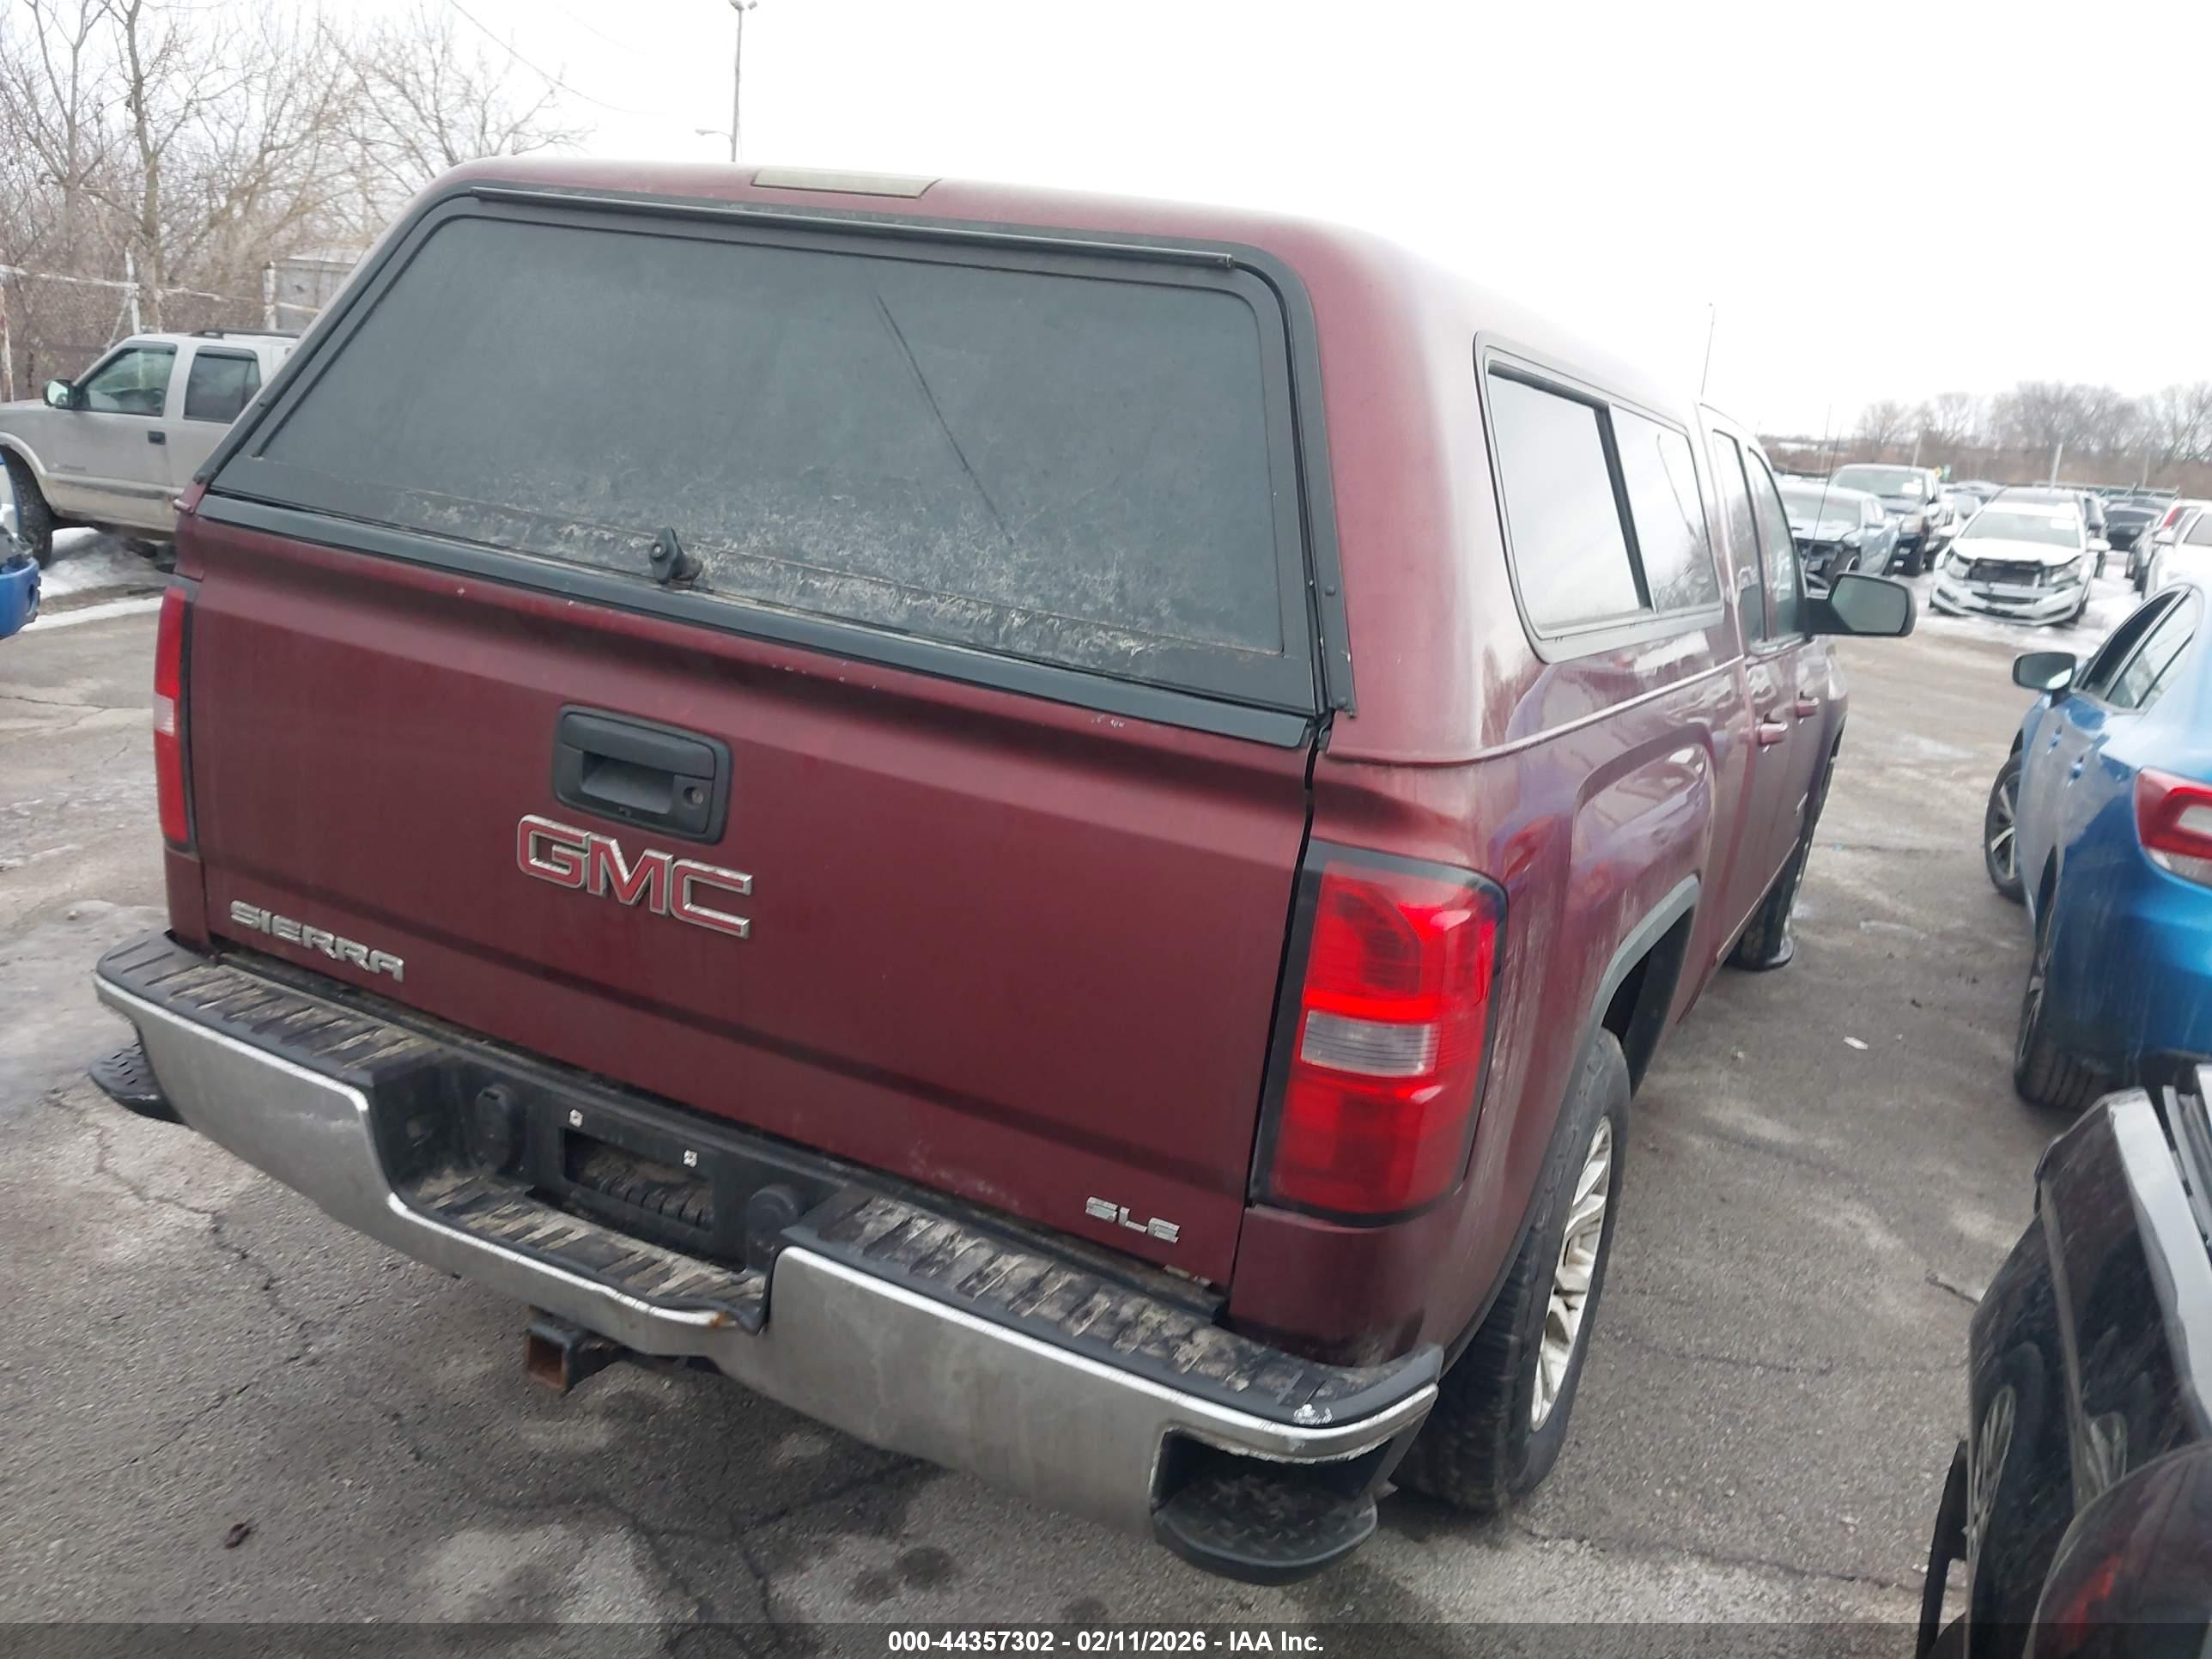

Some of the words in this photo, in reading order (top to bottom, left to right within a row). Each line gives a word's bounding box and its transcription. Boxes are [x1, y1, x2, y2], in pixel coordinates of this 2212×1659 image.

[517, 813, 753, 939] GMC
[230, 899, 405, 982] SIERRA
[1085, 1196, 1181, 1244] SLE
